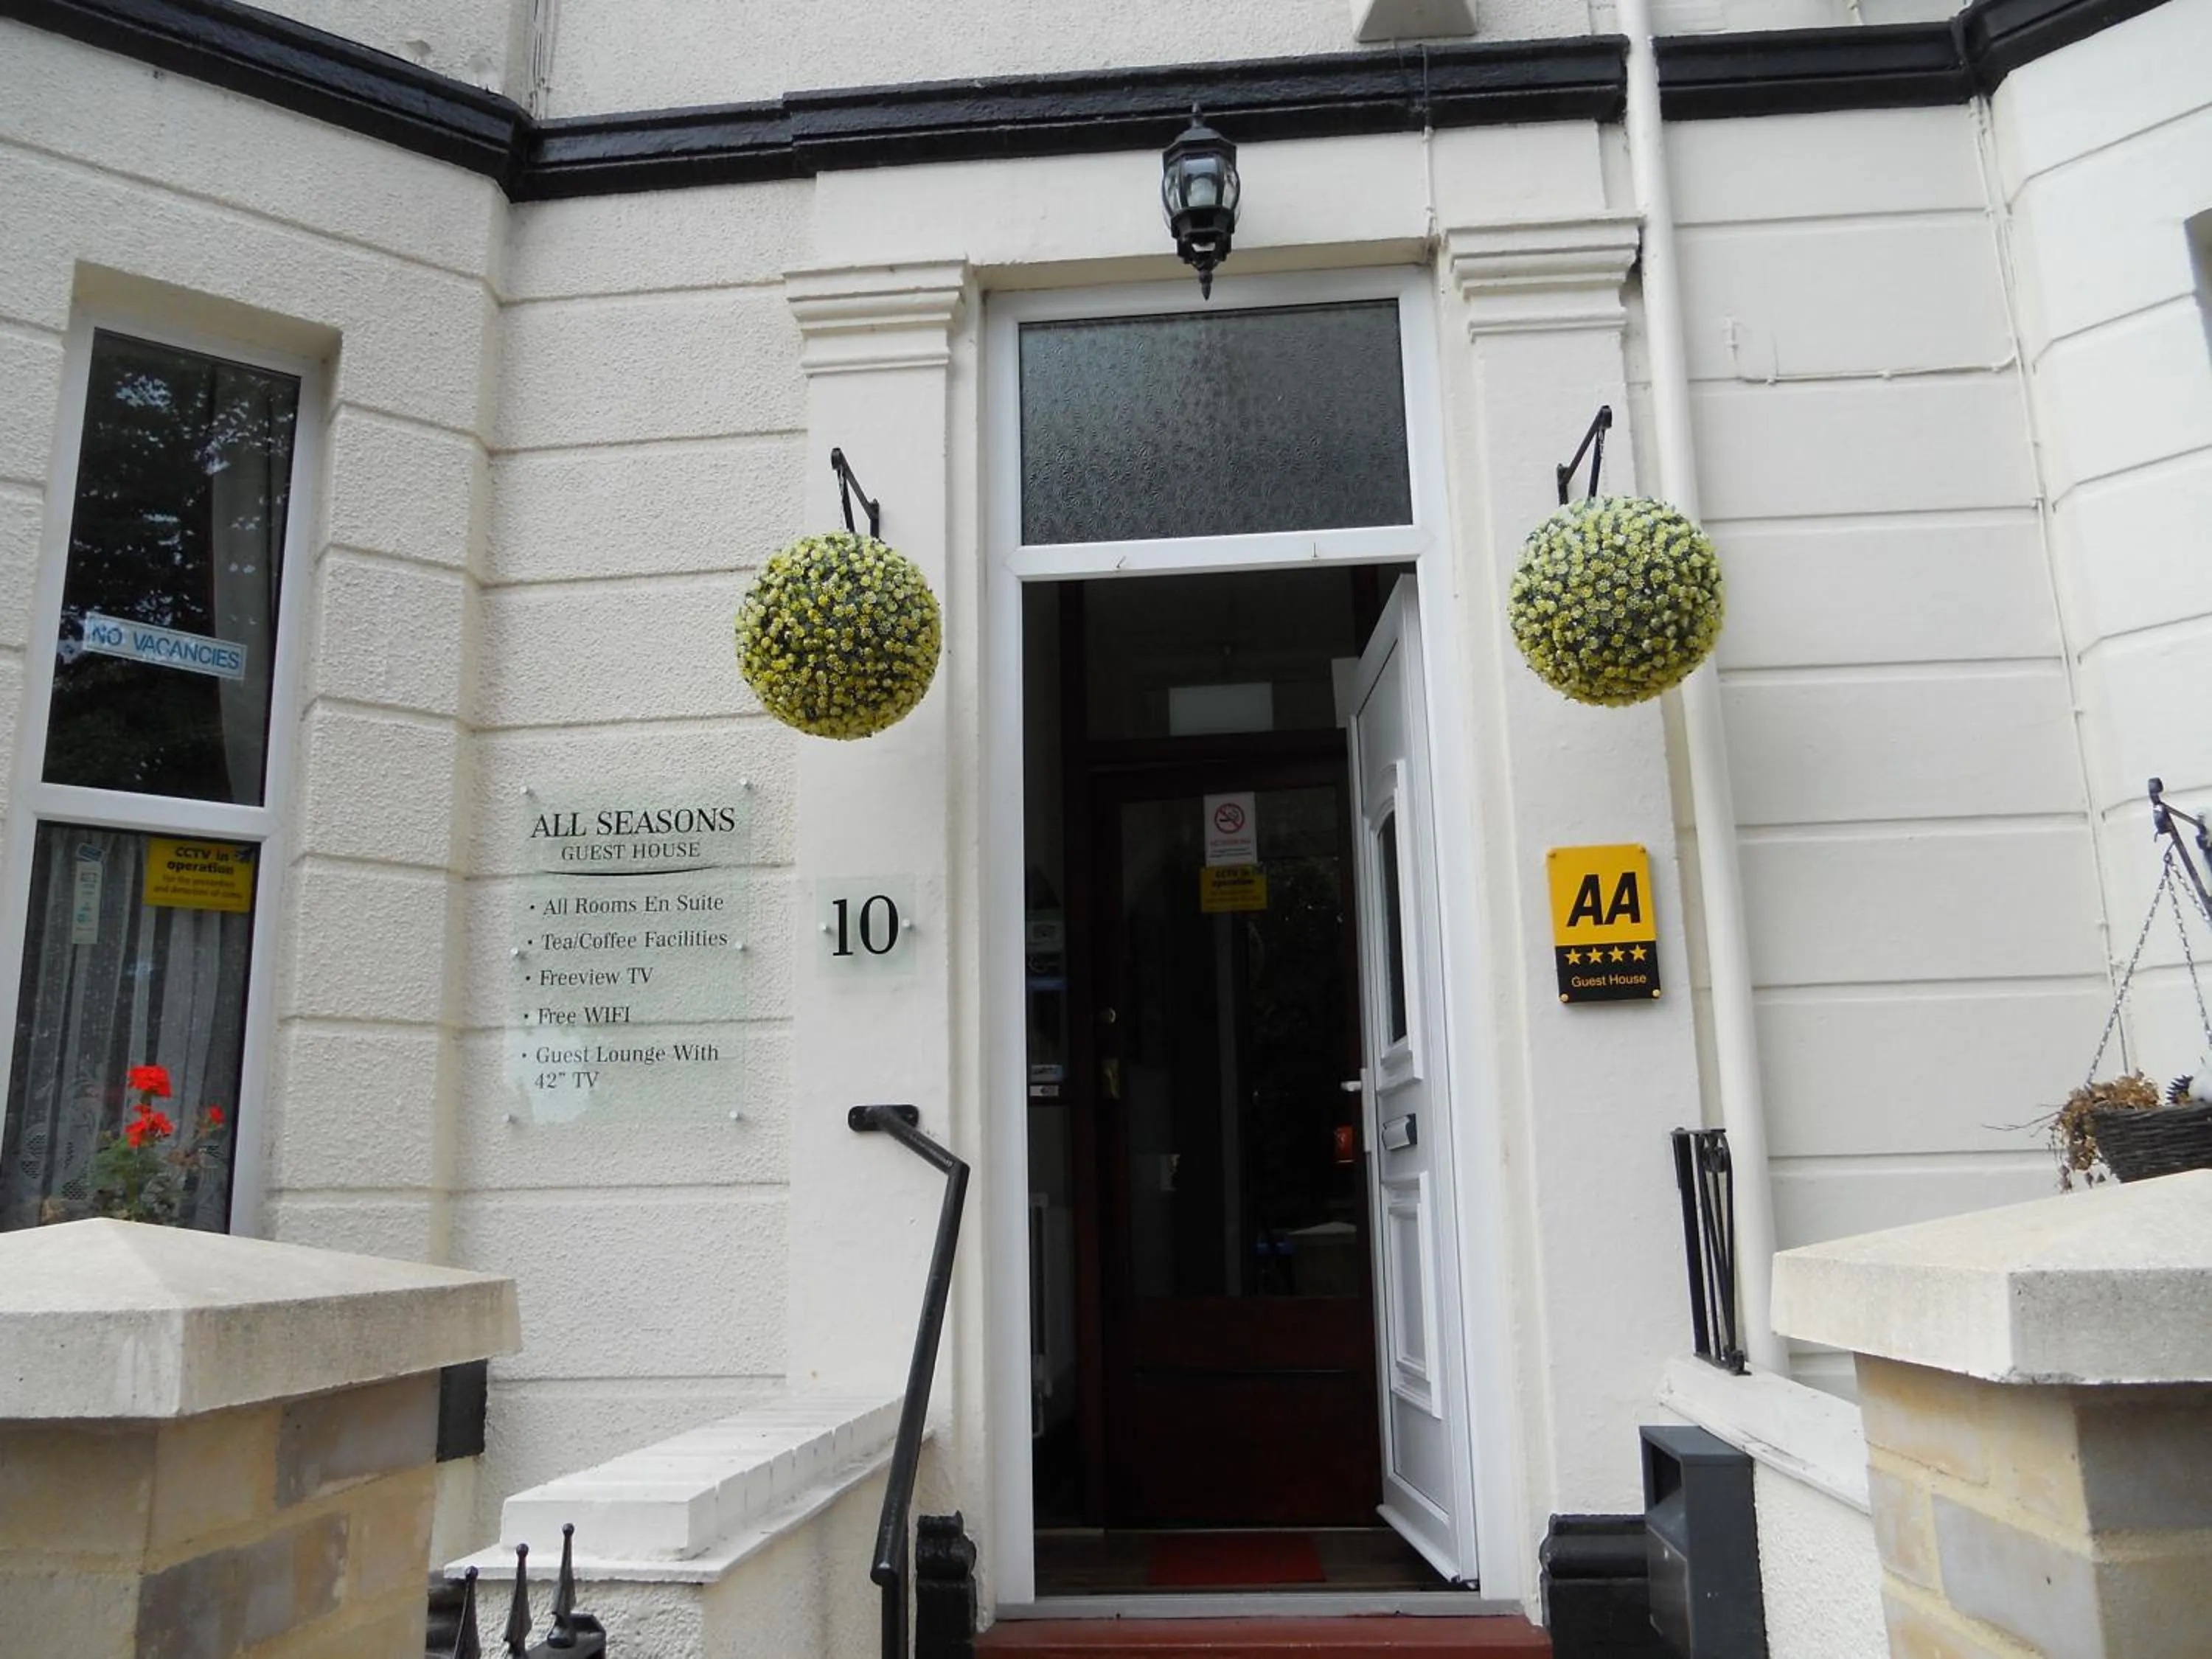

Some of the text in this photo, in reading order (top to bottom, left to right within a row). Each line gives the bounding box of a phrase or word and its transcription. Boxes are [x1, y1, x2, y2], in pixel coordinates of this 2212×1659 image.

[91, 626, 240, 670] NO VACANCIES
[530, 807, 736, 838] ALL SEASONS
[175, 846, 229, 861] CCTV in
[561, 842, 700, 861] GUEST HOUSE
[167, 860, 234, 874] operation
[543, 894, 724, 915] All Rooms En Suite
[1566, 872, 1641, 928] AA
[832, 894, 899, 956] 10
[541, 930, 728, 950] Tea/Coffee Facilities
[540, 967, 653, 986] Freeview TV
[1571, 973, 1646, 987] Guest House
[538, 1006, 630, 1024] Free WIFI
[536, 1044, 719, 1065] Guest Lounge With
[573, 1071, 599, 1088] TV
